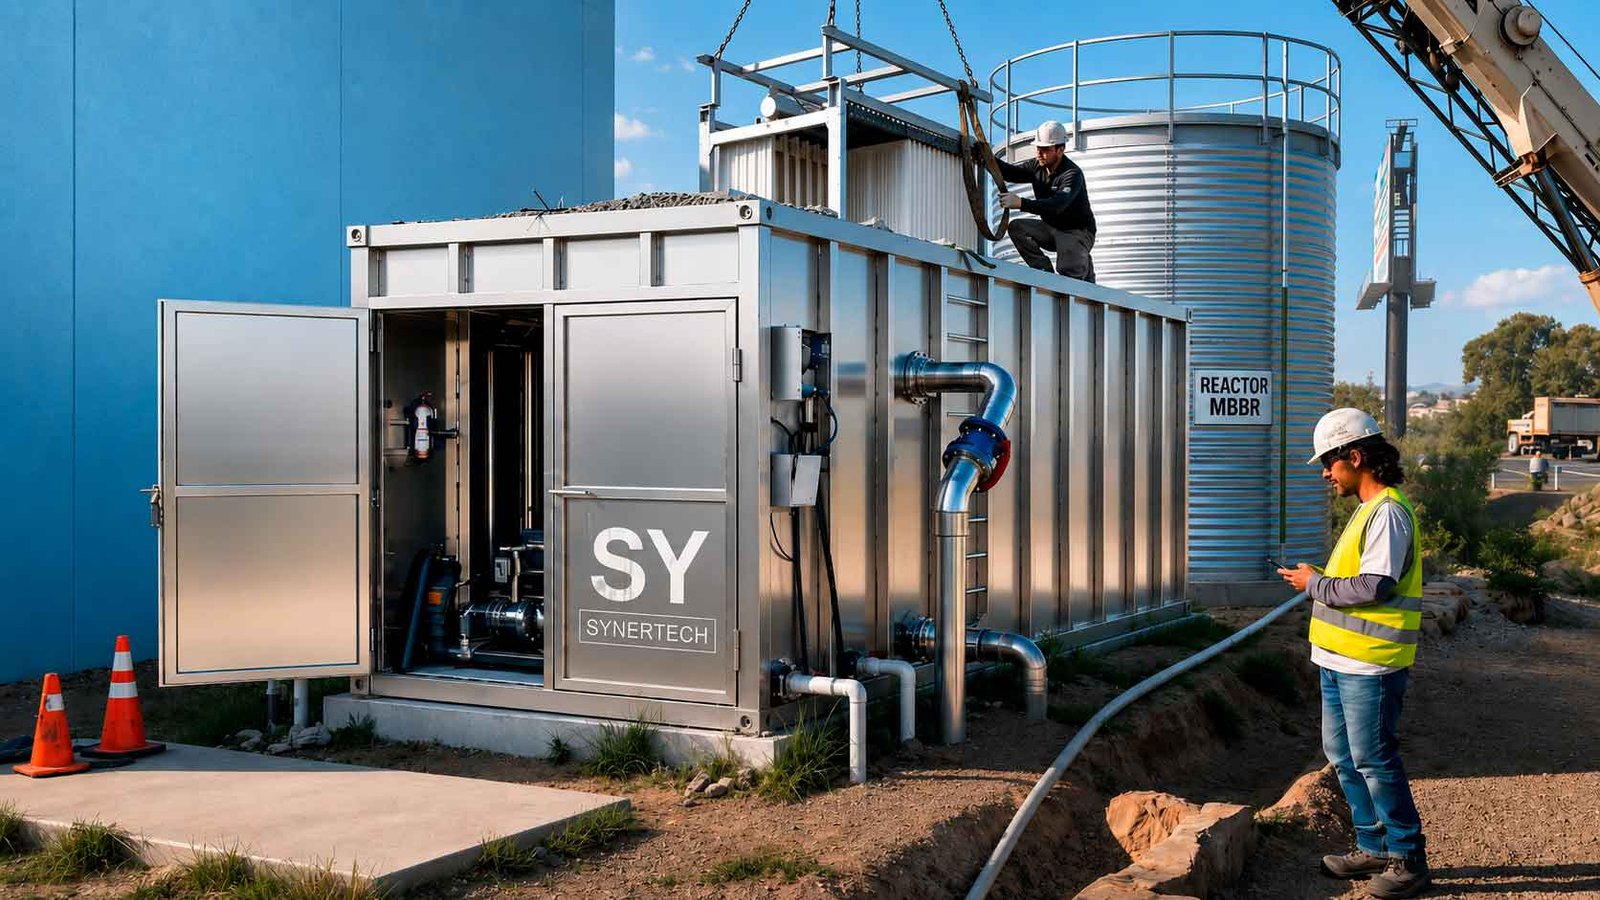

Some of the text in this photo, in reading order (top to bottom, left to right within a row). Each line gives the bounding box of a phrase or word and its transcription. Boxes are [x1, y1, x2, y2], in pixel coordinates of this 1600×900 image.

[1200, 377, 1268, 394] REACTOR
[1210, 398, 1260, 416] MBBR
[591, 527, 710, 604] SY
[586, 619, 708, 644] SYNERTECH
